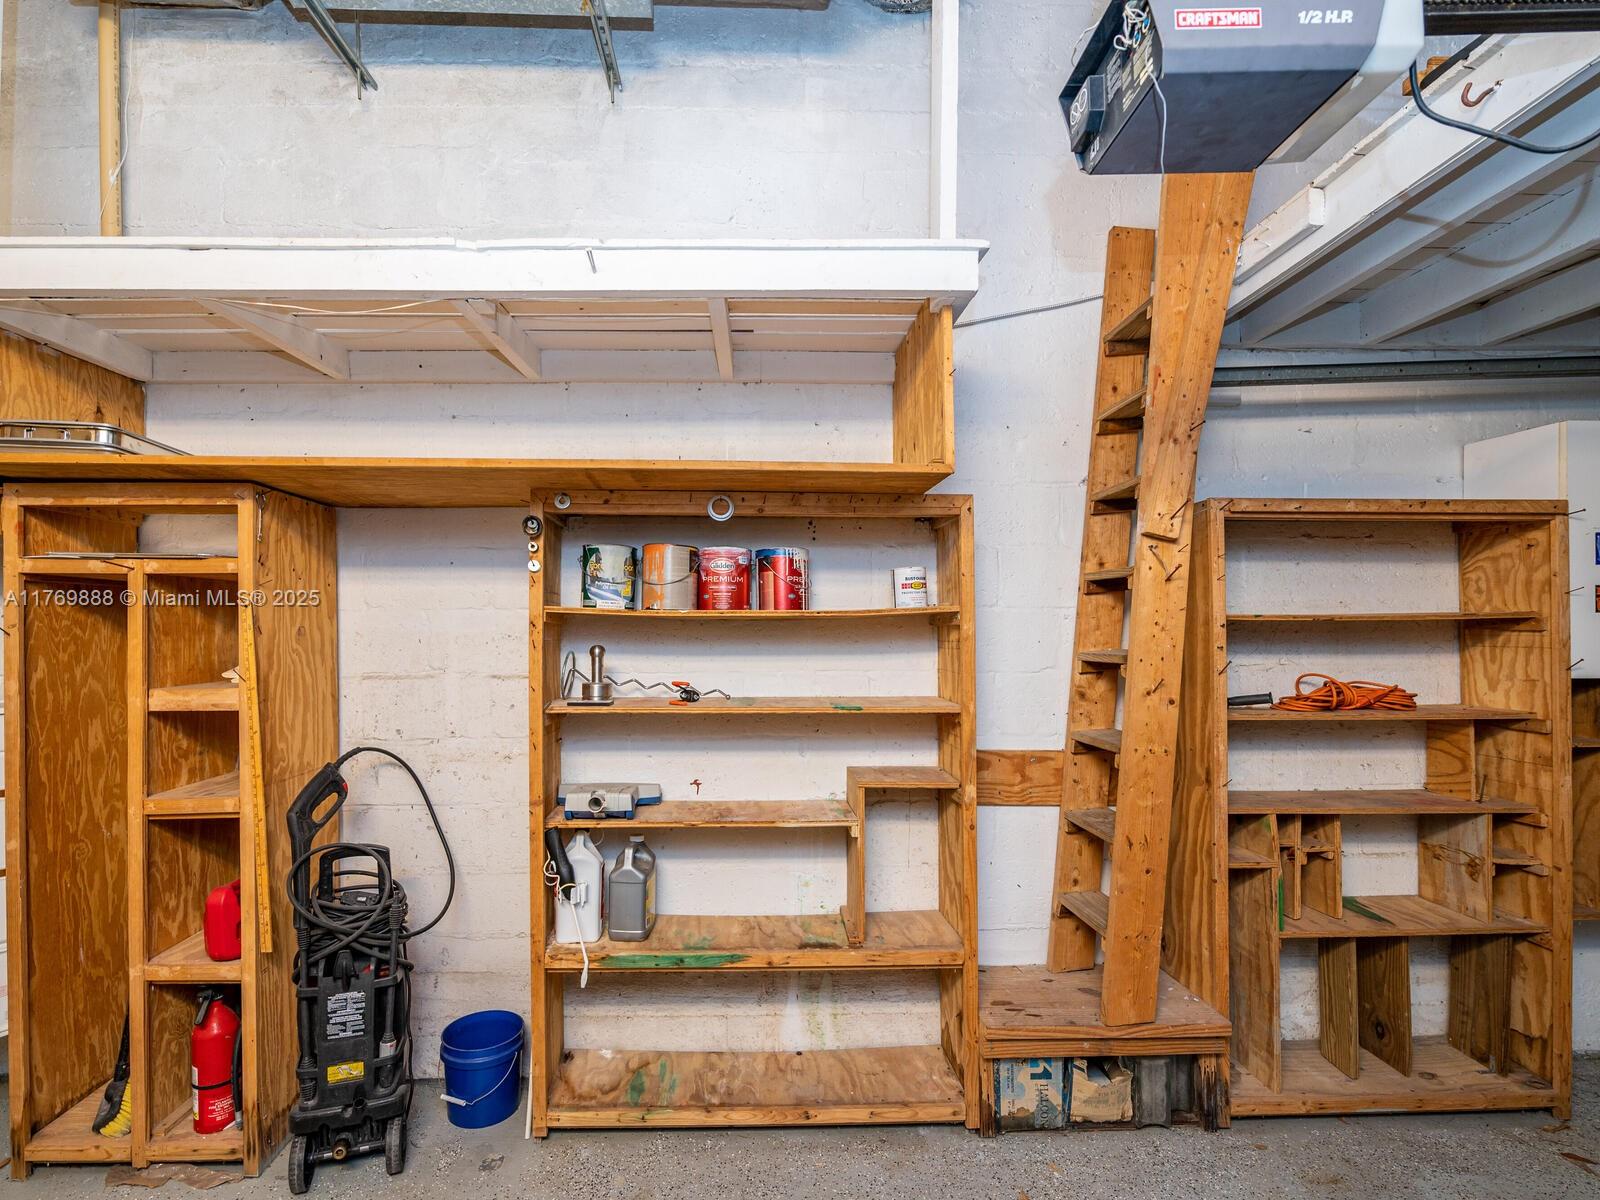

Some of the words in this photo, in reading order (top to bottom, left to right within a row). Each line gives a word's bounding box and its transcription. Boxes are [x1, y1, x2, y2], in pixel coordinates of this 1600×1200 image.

[1177, 11, 1259, 26] CRAFTSMAN
[1297, 10, 1323, 25] 1/2
[710, 560, 735, 570] Glidden
[703, 575, 744, 583] PREMIUM
